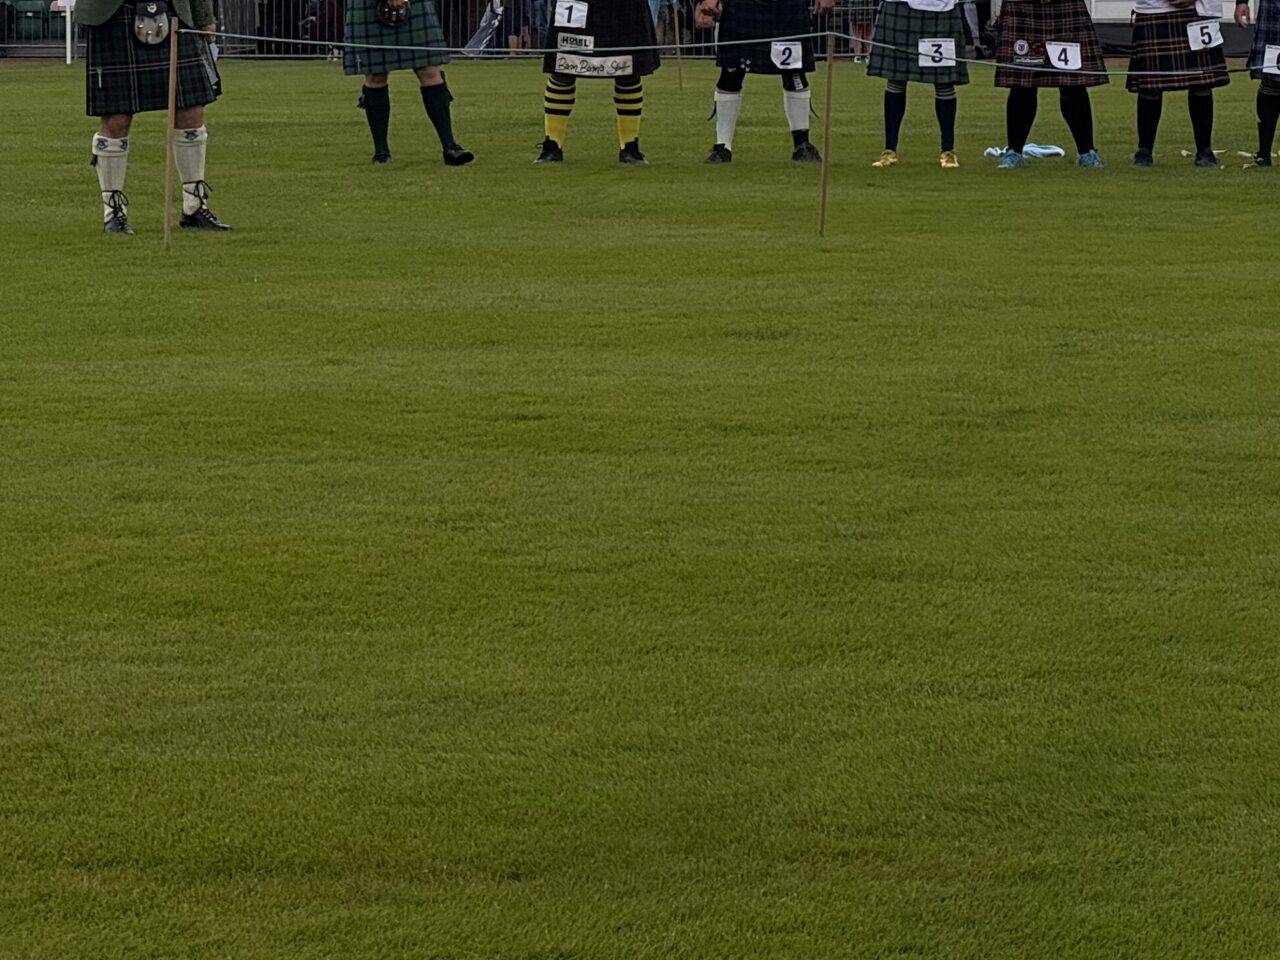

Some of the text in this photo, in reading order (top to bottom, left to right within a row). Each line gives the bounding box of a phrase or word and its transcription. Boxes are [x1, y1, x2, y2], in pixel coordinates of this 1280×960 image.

[564, 4, 574, 24] 1
[1199, 25, 1212, 45] 5
[780, 47, 793, 66] 2
[931, 44, 943, 63] 3
[1057, 47, 1069, 66] 4
